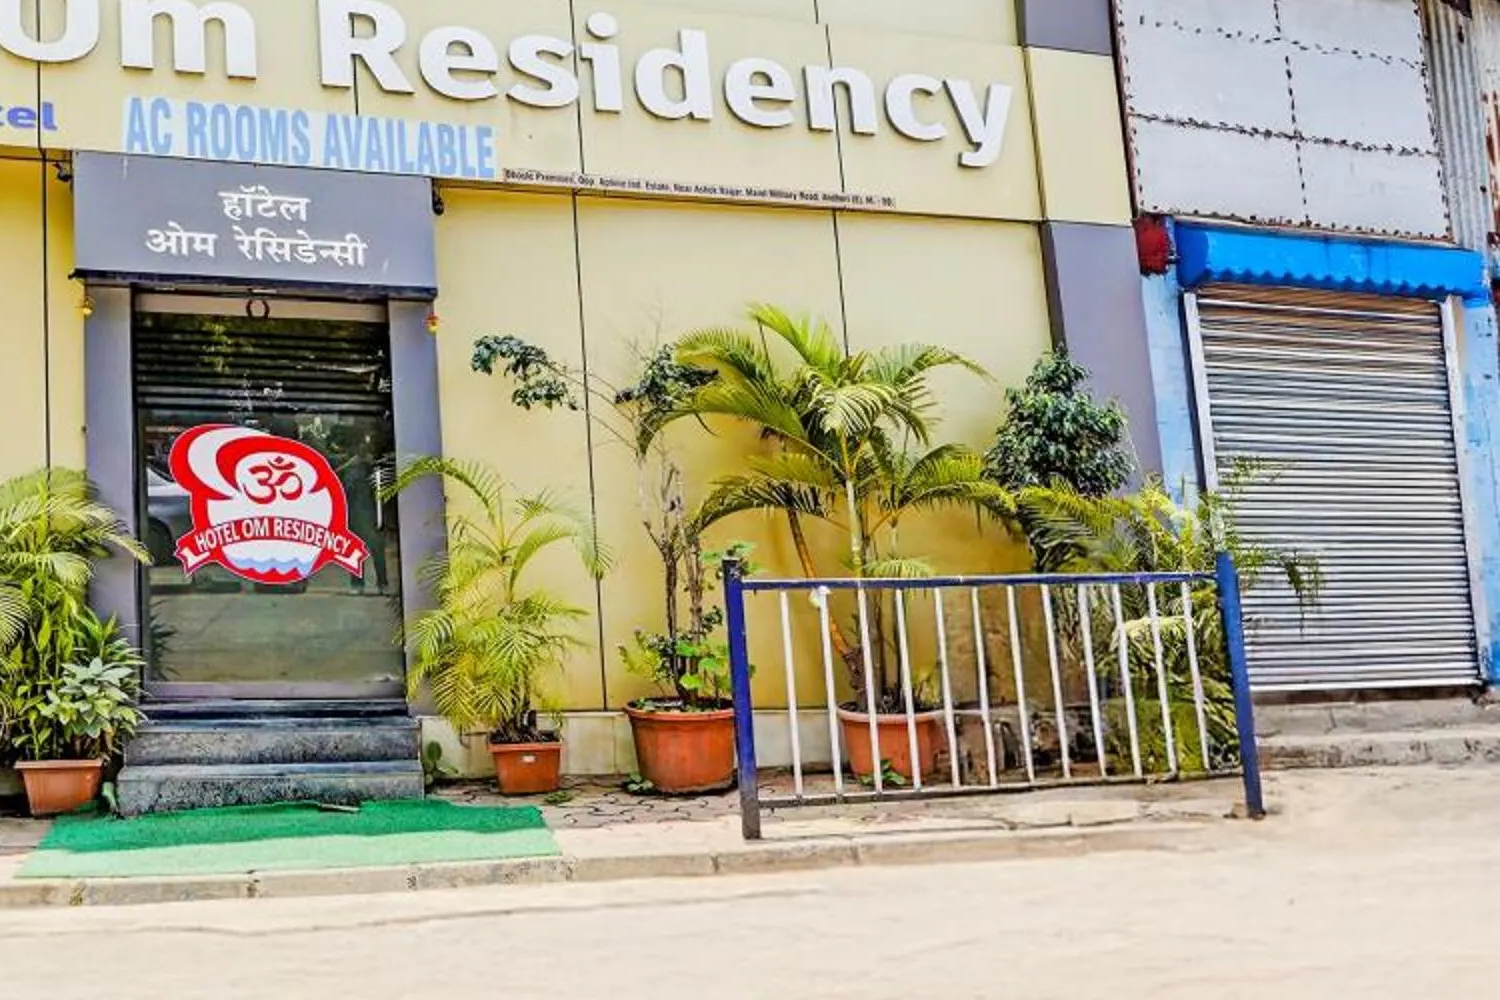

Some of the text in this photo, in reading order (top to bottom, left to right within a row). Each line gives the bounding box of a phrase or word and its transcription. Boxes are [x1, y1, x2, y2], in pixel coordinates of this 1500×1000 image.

[126, 96, 496, 179] AC ROOMS AVAILABLE
[219, 184, 310, 223] हॉटेल
[146, 221, 368, 268] ओम रेसिडेन्सी
[195, 521, 350, 555] HOTEL OM RESIDENCY
